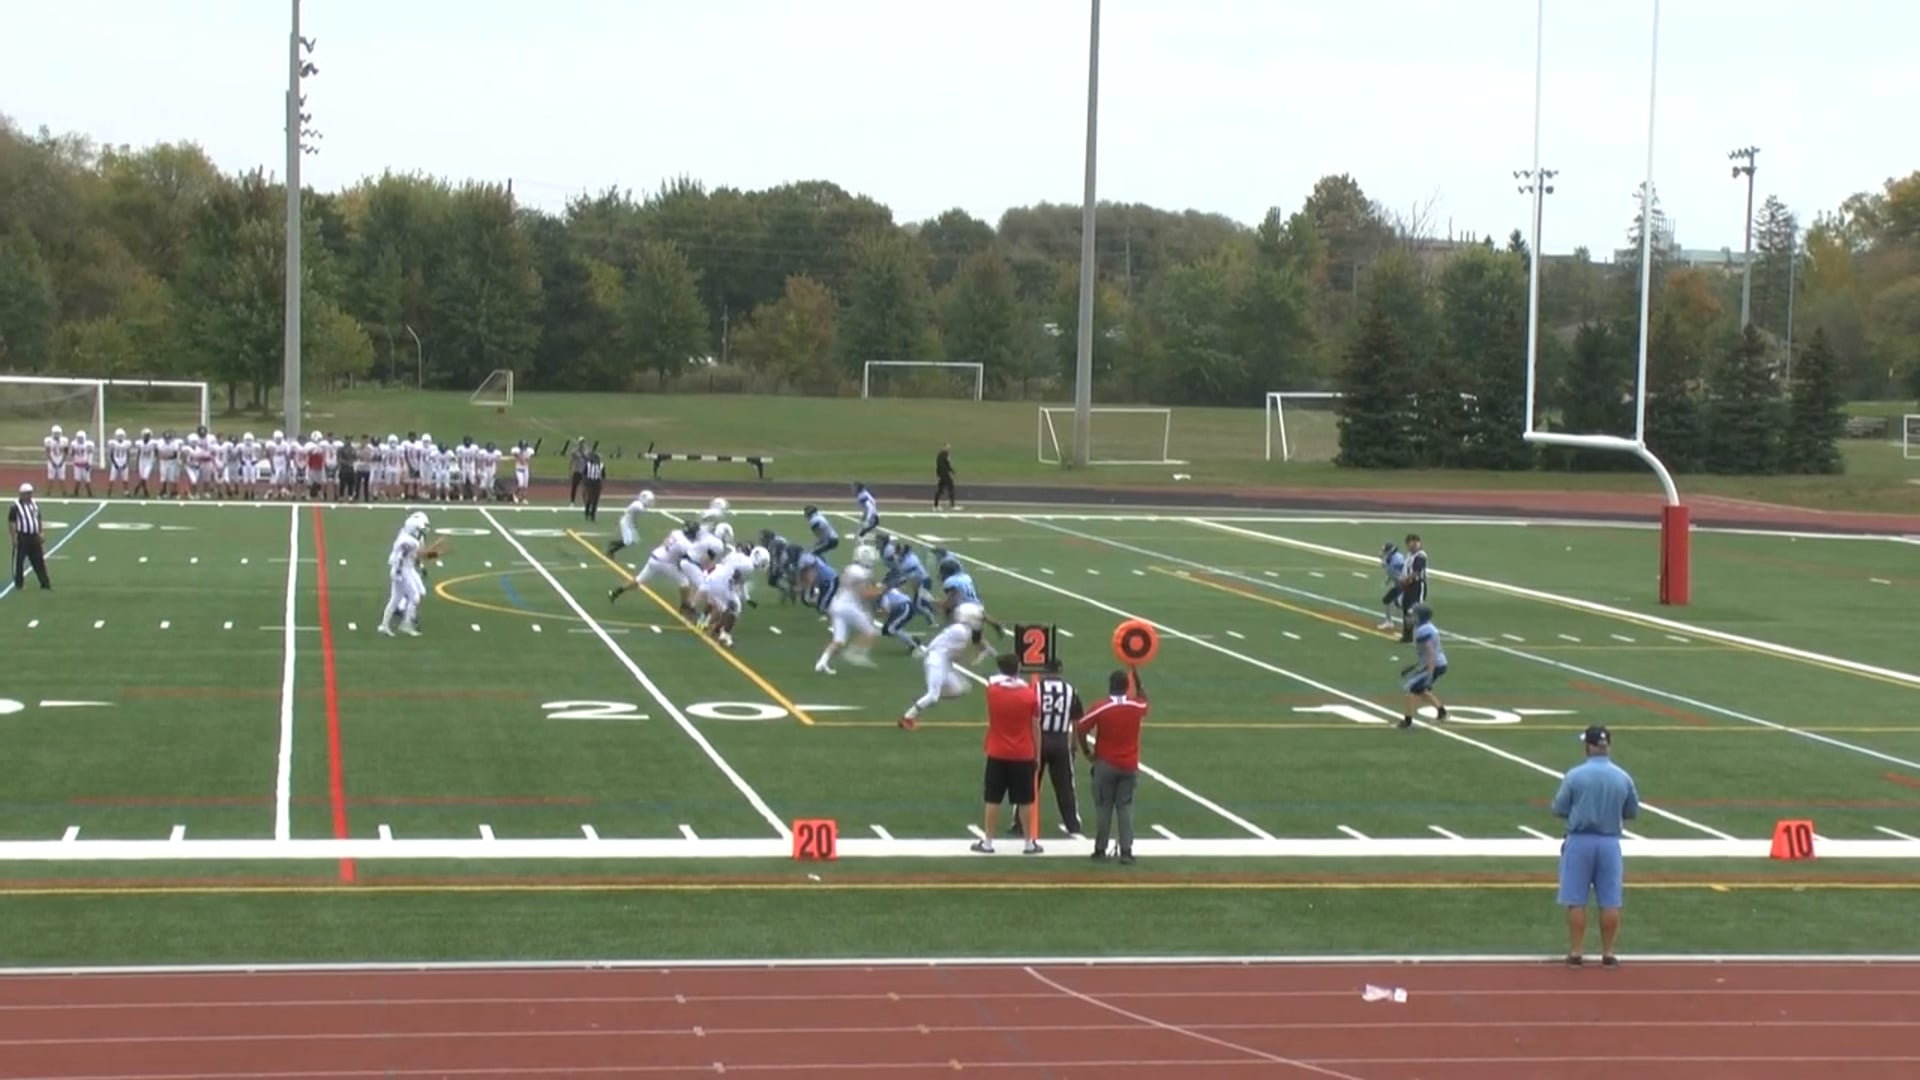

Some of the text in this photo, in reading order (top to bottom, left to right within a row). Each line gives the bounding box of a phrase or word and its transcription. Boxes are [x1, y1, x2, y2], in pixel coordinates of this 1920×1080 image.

[1023, 628, 1046, 664] 2
[1042, 695, 1064, 713] 24
[798, 824, 832, 858] 20
[1782, 824, 1813, 858] 10
